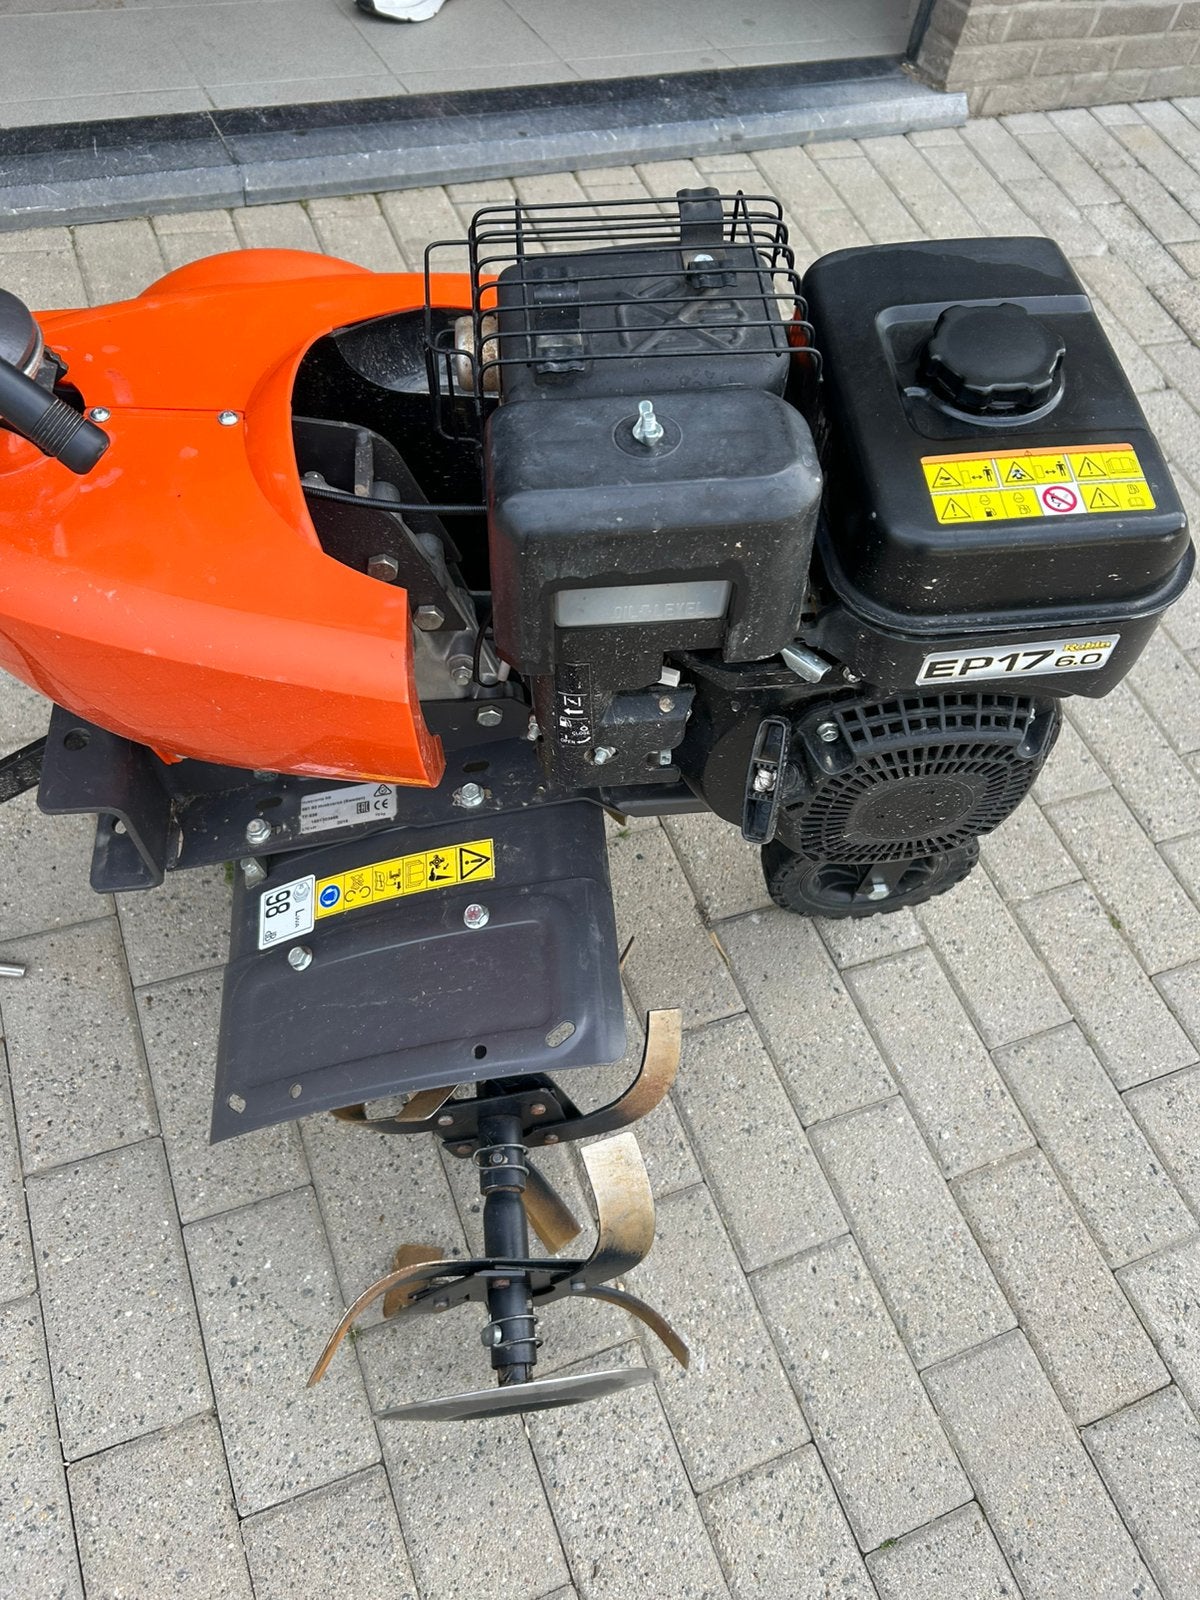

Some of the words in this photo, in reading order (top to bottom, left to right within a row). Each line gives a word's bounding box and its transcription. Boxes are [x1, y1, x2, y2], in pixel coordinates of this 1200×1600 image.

[613, 604, 638, 619] OIL
[652, 601, 705, 619] LEVEL
[1062, 641, 1111, 652] Robin
[923, 649, 1055, 679] EP17
[1055, 652, 1102, 669] 6.0
[560, 737, 576, 745] OPEN
[374, 798, 389, 811] CE
[265, 890, 290, 918] 98
